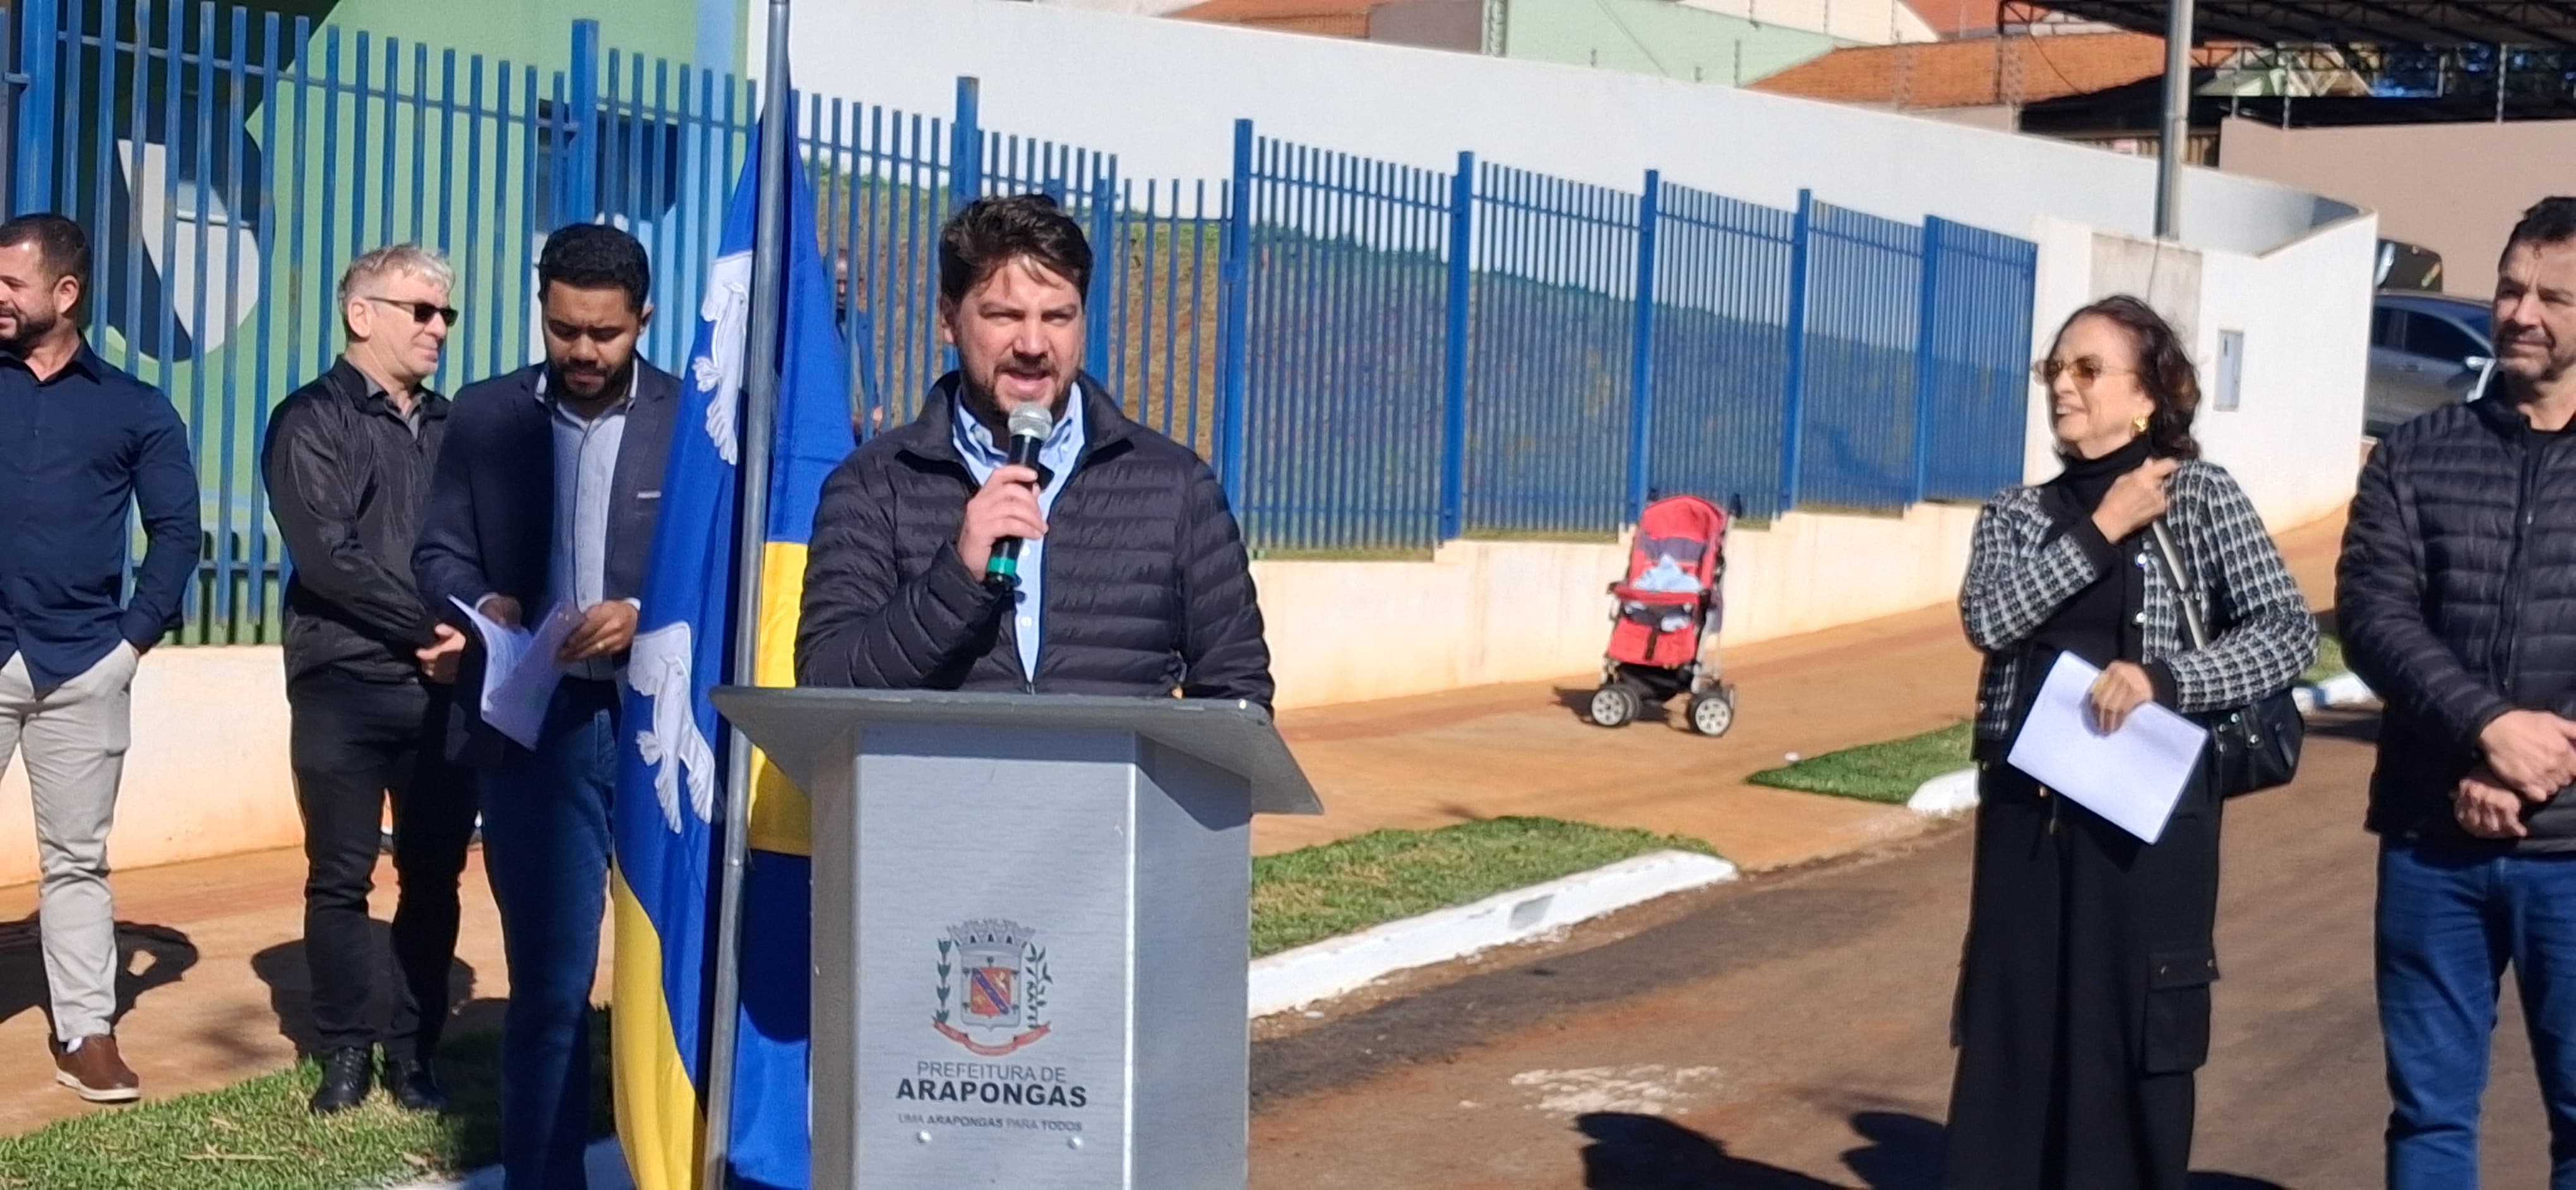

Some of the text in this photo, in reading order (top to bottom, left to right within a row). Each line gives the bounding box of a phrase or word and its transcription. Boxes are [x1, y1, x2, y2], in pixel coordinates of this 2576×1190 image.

[917, 1061, 1067, 1083] PREFEITURA DE
[896, 1078, 1087, 1108] ARAPONGAS
[898, 1113, 1083, 1132] UMA ARAPONGAS PARA TODOS
